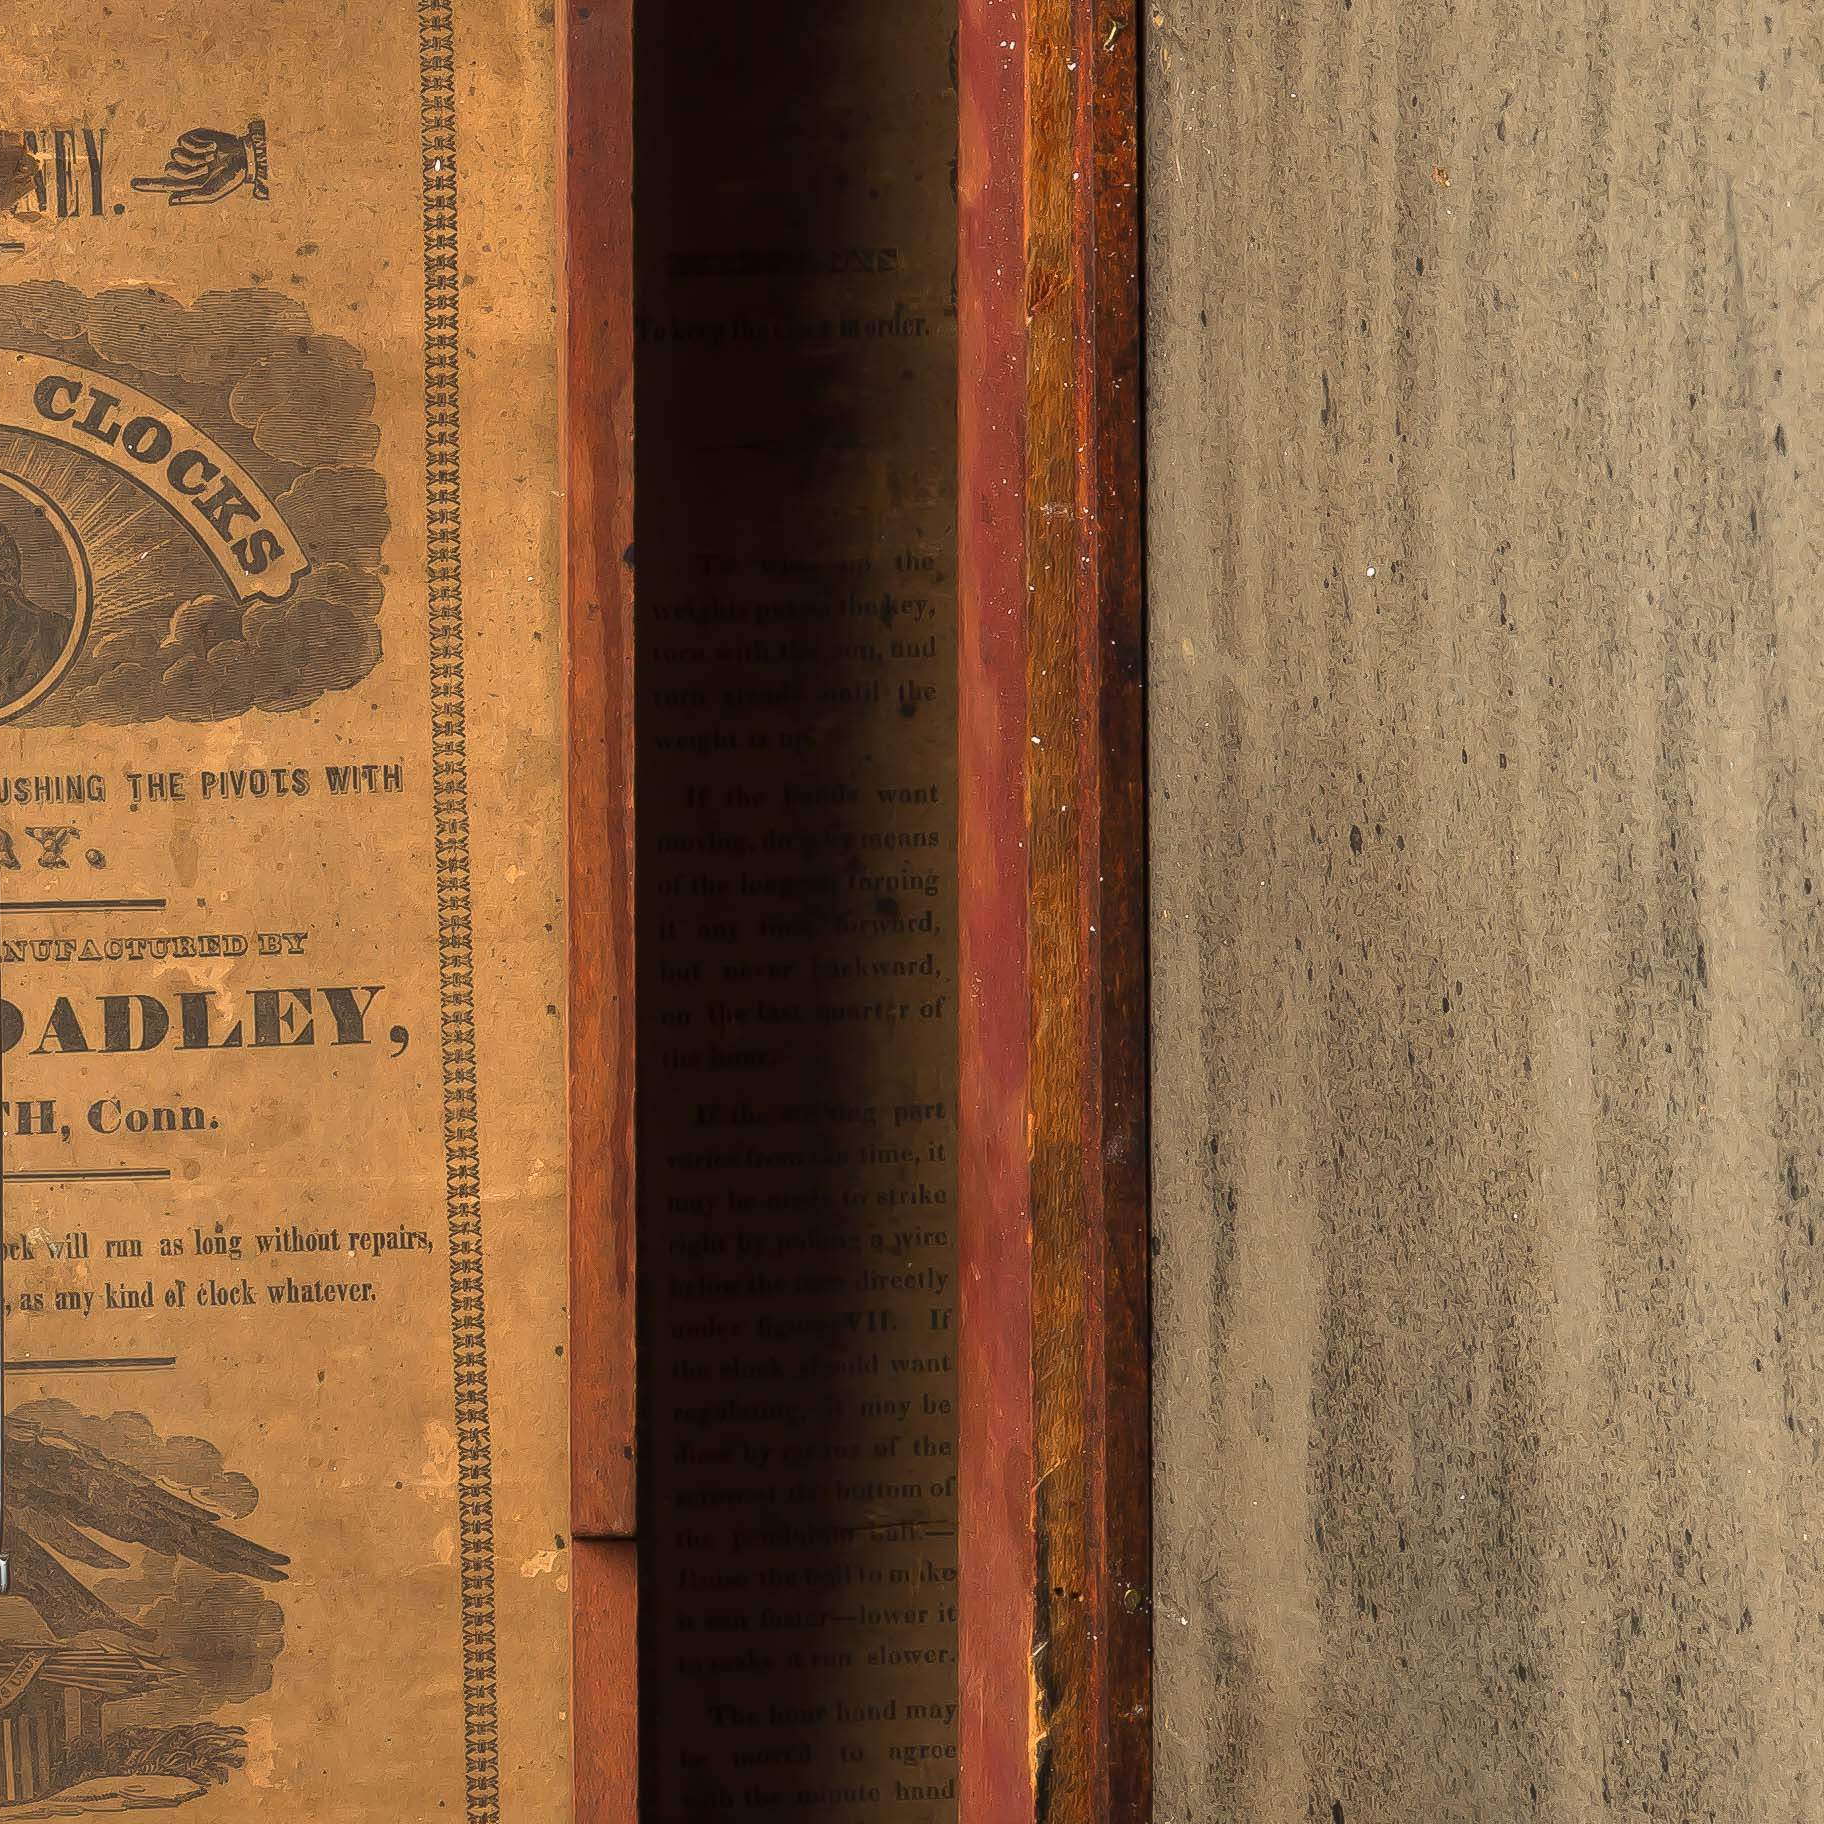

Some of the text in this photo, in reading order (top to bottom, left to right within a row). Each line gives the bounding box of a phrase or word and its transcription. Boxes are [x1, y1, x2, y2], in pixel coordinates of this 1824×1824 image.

[865, 314, 931, 338] order.
[33, 375, 285, 576] CLOCKS
[894, 553, 936, 574] the
[898, 680, 938, 702] the
[127, 770, 188, 803] THE
[201, 767, 312, 800] PIVOTS
[327, 764, 406, 795] WITH
[877, 785, 939, 804] want
[860, 830, 941, 853] means
[259, 931, 310, 957] BY
[918, 995, 945, 1021] of
[87, 1097, 220, 1134] Conn.
[893, 1099, 947, 1126] part
[858, 1142, 947, 1166] time, it
[876, 1185, 948, 1205] strike
[47, 1232, 91, 1261] will
[104, 1238, 144, 1259] run
[159, 1236, 187, 1258] as
[195, 1230, 244, 1260] long
[258, 1225, 344, 1253] without
[349, 1223, 437, 1258] repairs,
[18, 1292, 45, 1313] as
[55, 1290, 96, 1319] any
[104, 1283, 156, 1311] kind
[165, 1281, 188, 1308] of
[197, 1279, 259, 1307] clock
[267, 1277, 380, 1306] whatever.
[929, 1309, 953, 1330] If
[890, 1354, 953, 1374] want
[859, 1393, 952, 1420] may be
[873, 1435, 952, 1459] of the
[835, 1476, 957, 1501] bottom of
[938, 1605, 957, 1624] it
[867, 1644, 957, 1666] slower.
[835, 1700, 896, 1722] hand
[904, 1703, 957, 1726] may
[888, 1742, 957, 1766] agree
[894, 1778, 956, 1802] hand
